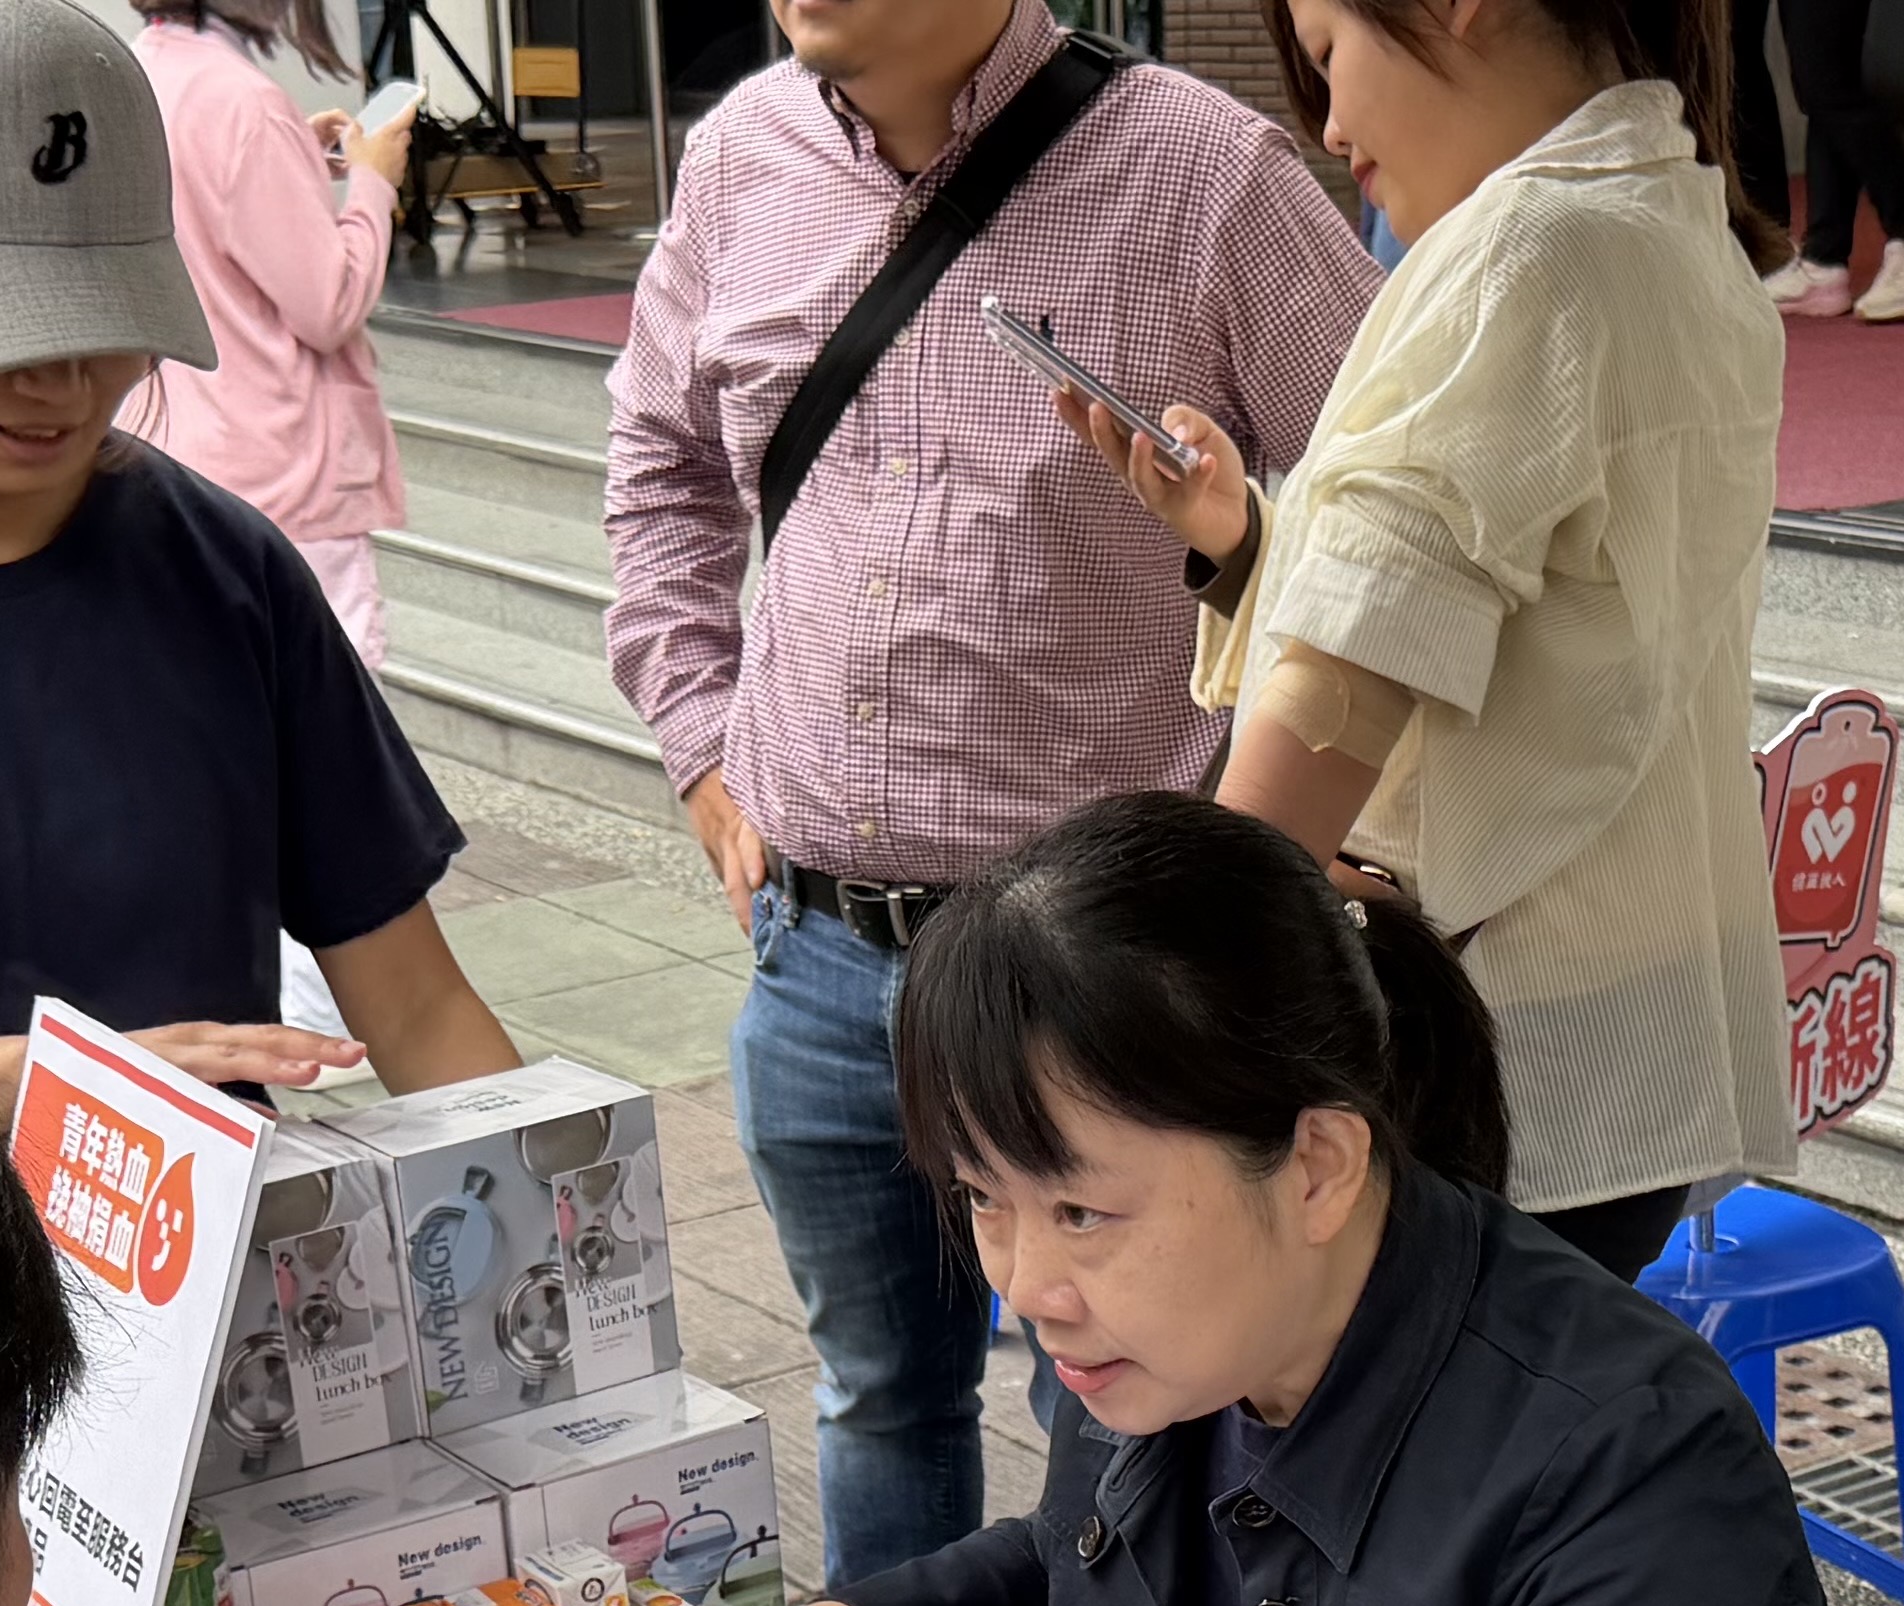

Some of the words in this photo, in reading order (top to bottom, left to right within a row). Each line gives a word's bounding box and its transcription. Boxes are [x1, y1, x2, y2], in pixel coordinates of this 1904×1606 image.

[59, 1102, 152, 1206] 青年熱血
[423, 1219, 460, 1332] DESIGN
[438, 1336, 469, 1402] NEW
[678, 1464, 709, 1483] New
[398, 1549, 431, 1568] New
